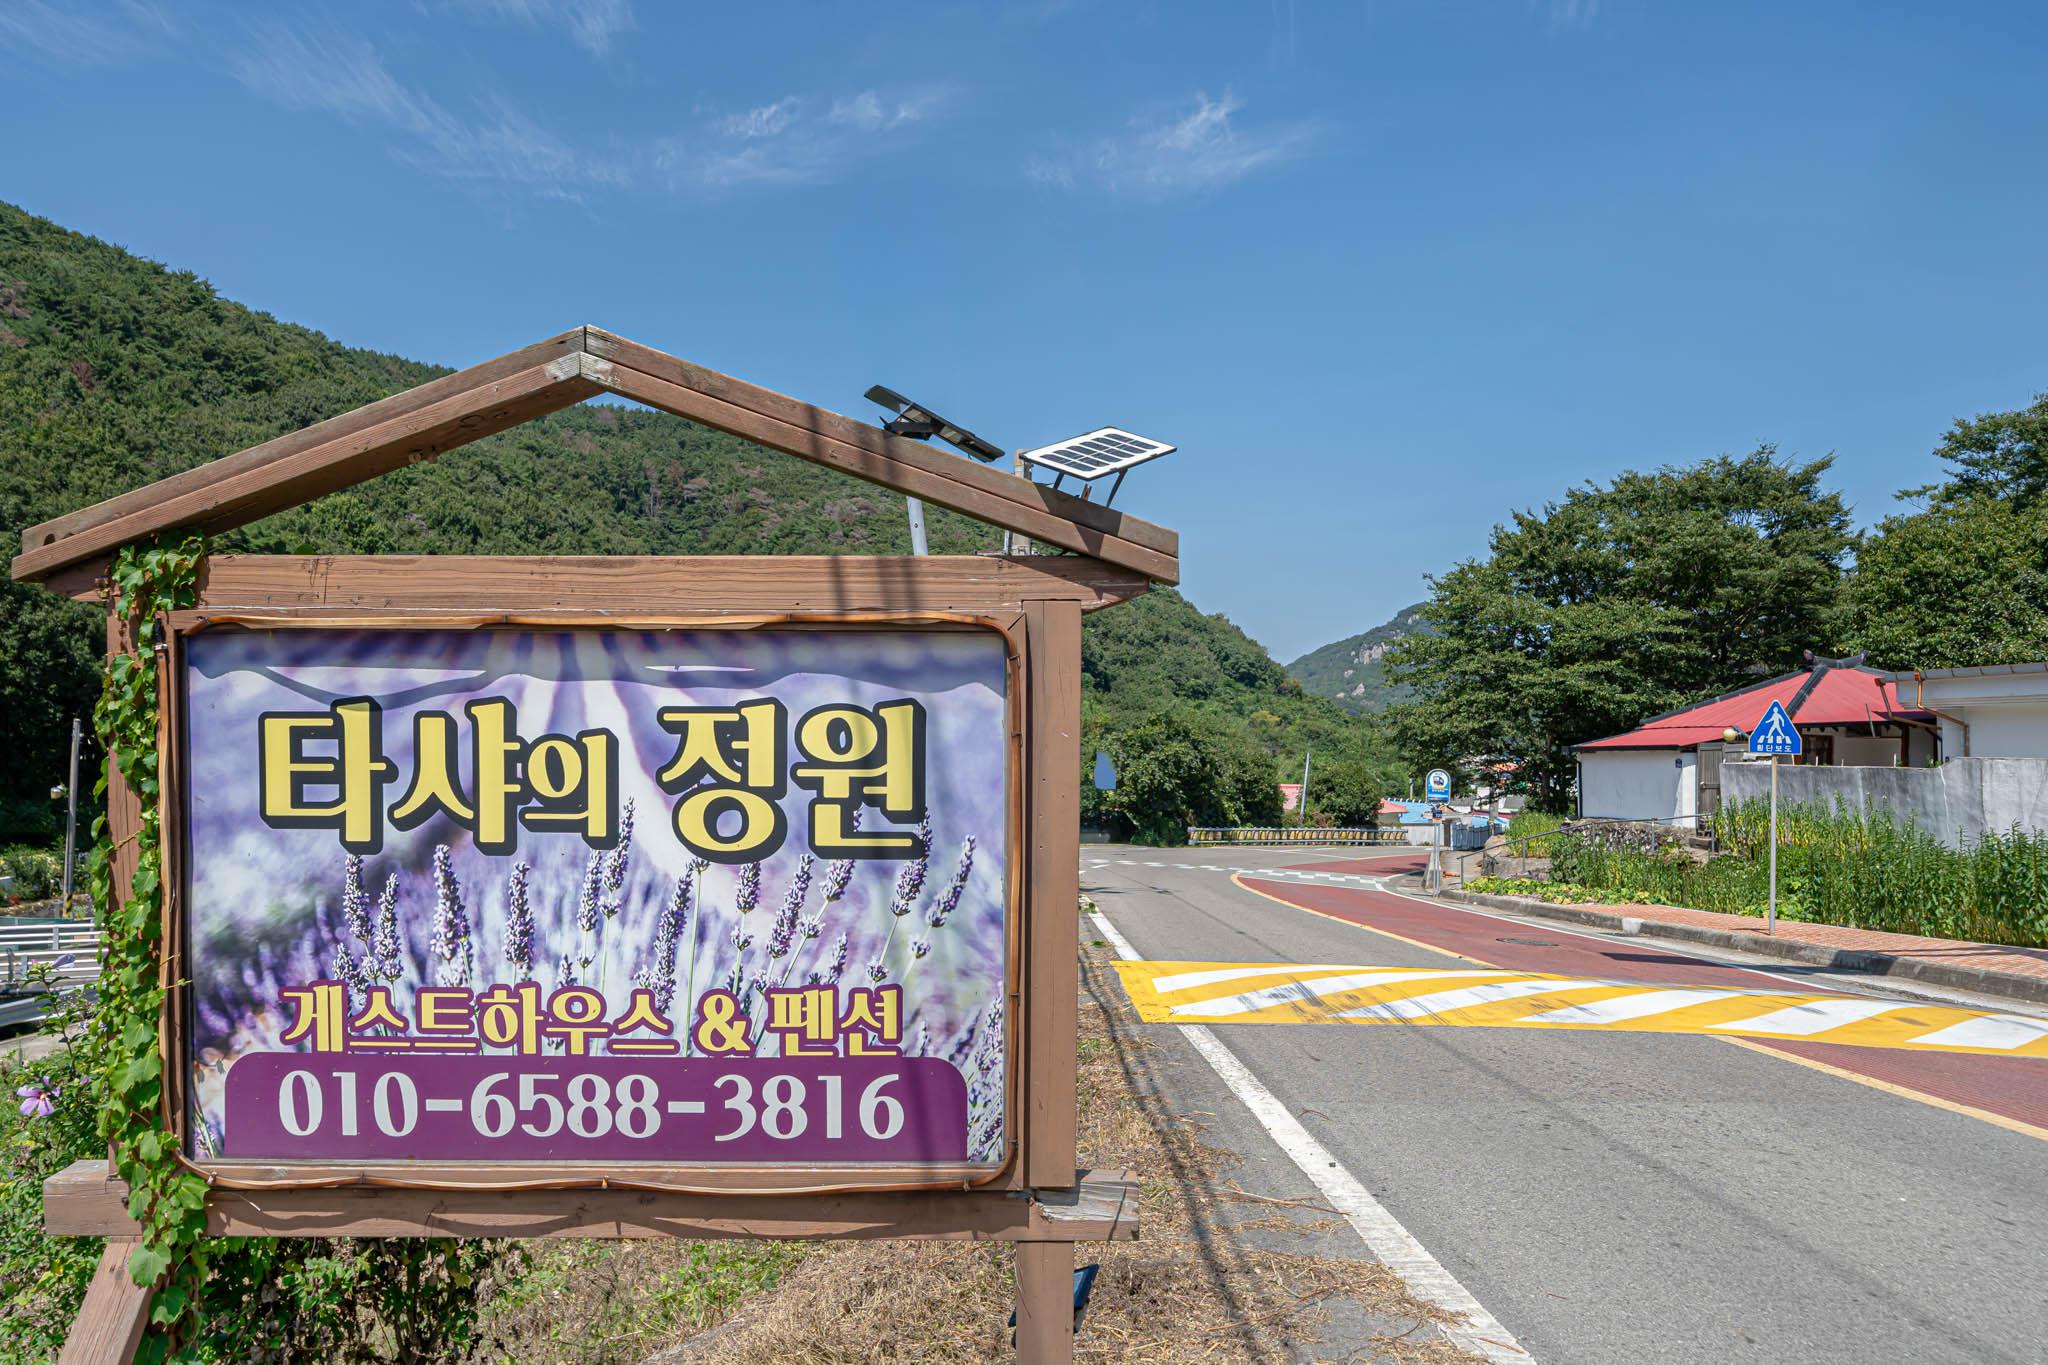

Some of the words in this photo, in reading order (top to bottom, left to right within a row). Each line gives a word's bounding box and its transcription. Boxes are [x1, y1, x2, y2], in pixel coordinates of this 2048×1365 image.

[260, 698, 617, 853] 타샤의
[658, 698, 923, 862] 정원
[281, 985, 679, 1055] 게스트하우스
[700, 994, 752, 1052] &
[768, 988, 900, 1057] 펜션
[278, 1069, 905, 1142] 010-6588-3816
